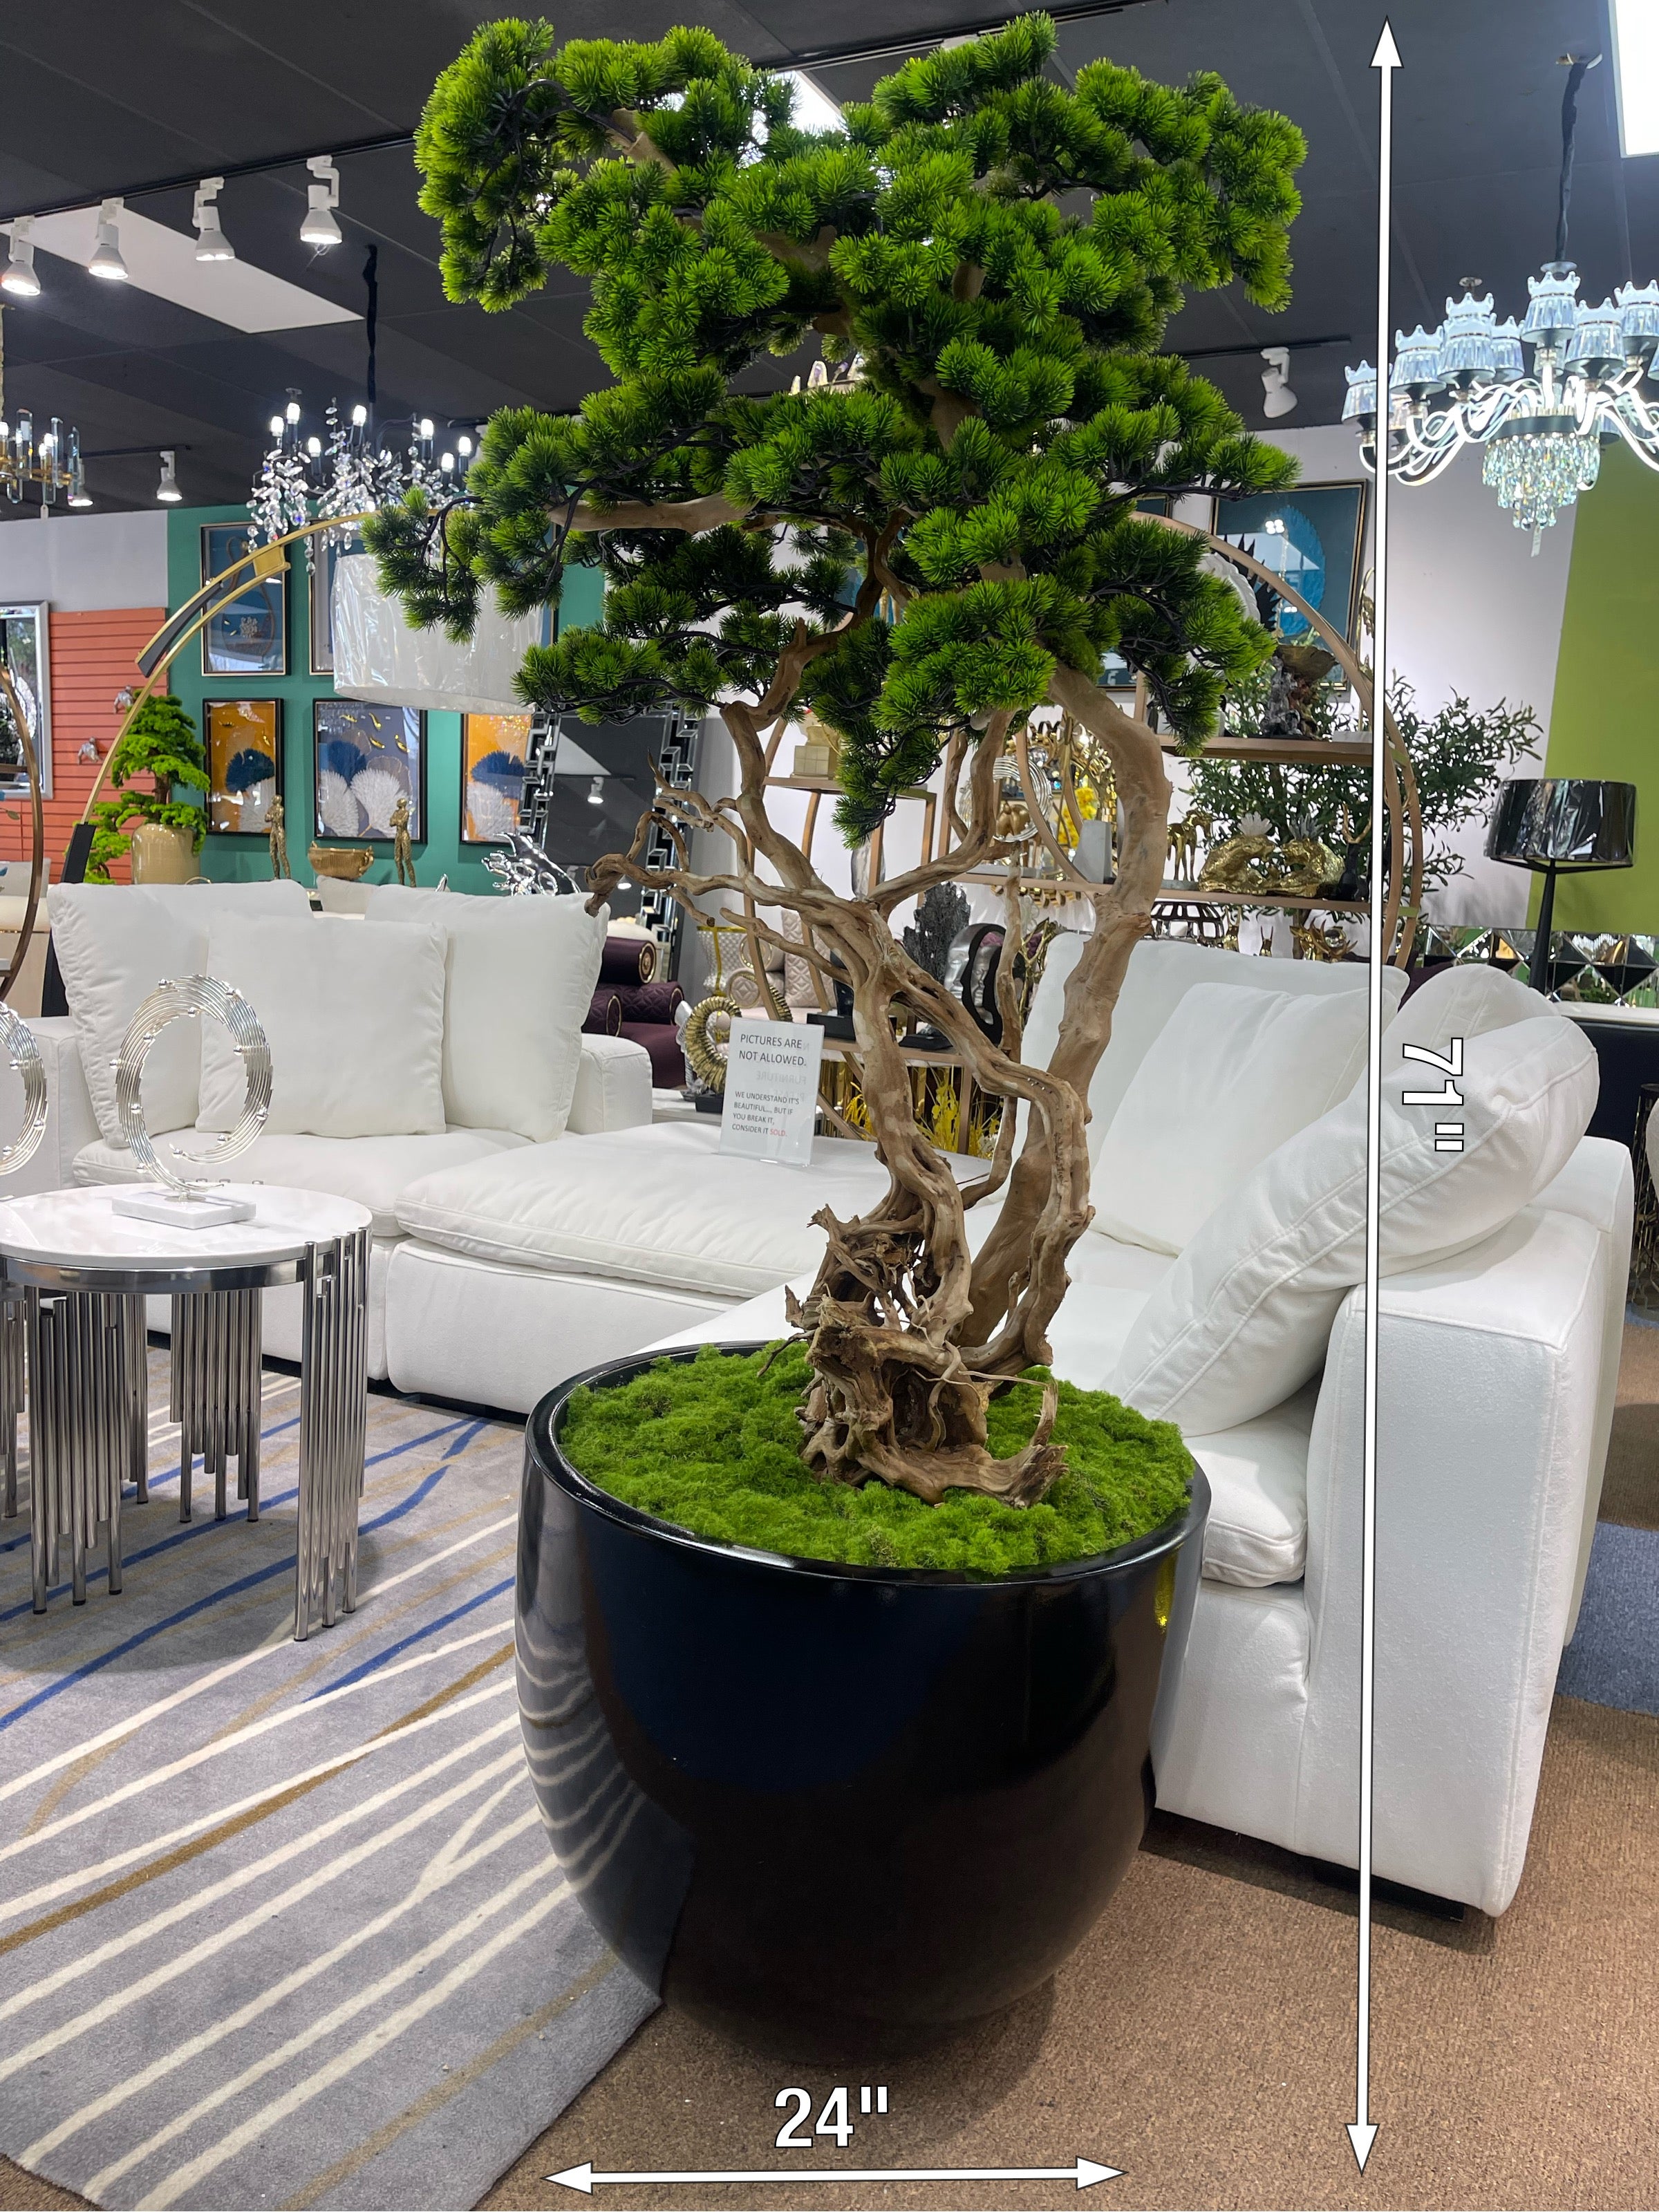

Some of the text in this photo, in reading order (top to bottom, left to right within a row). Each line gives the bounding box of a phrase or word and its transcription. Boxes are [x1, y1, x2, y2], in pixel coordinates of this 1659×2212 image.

[740, 1034, 782, 1047] PICTURES
[784, 1039, 802, 1048] ARE
[739, 1051, 806, 1066] NOT ALLOWED.
[746, 1093, 787, 1103] UNDERSTAND
[747, 1115, 766, 1123] BREAK
[732, 1124, 762, 1133] CONSIDER
